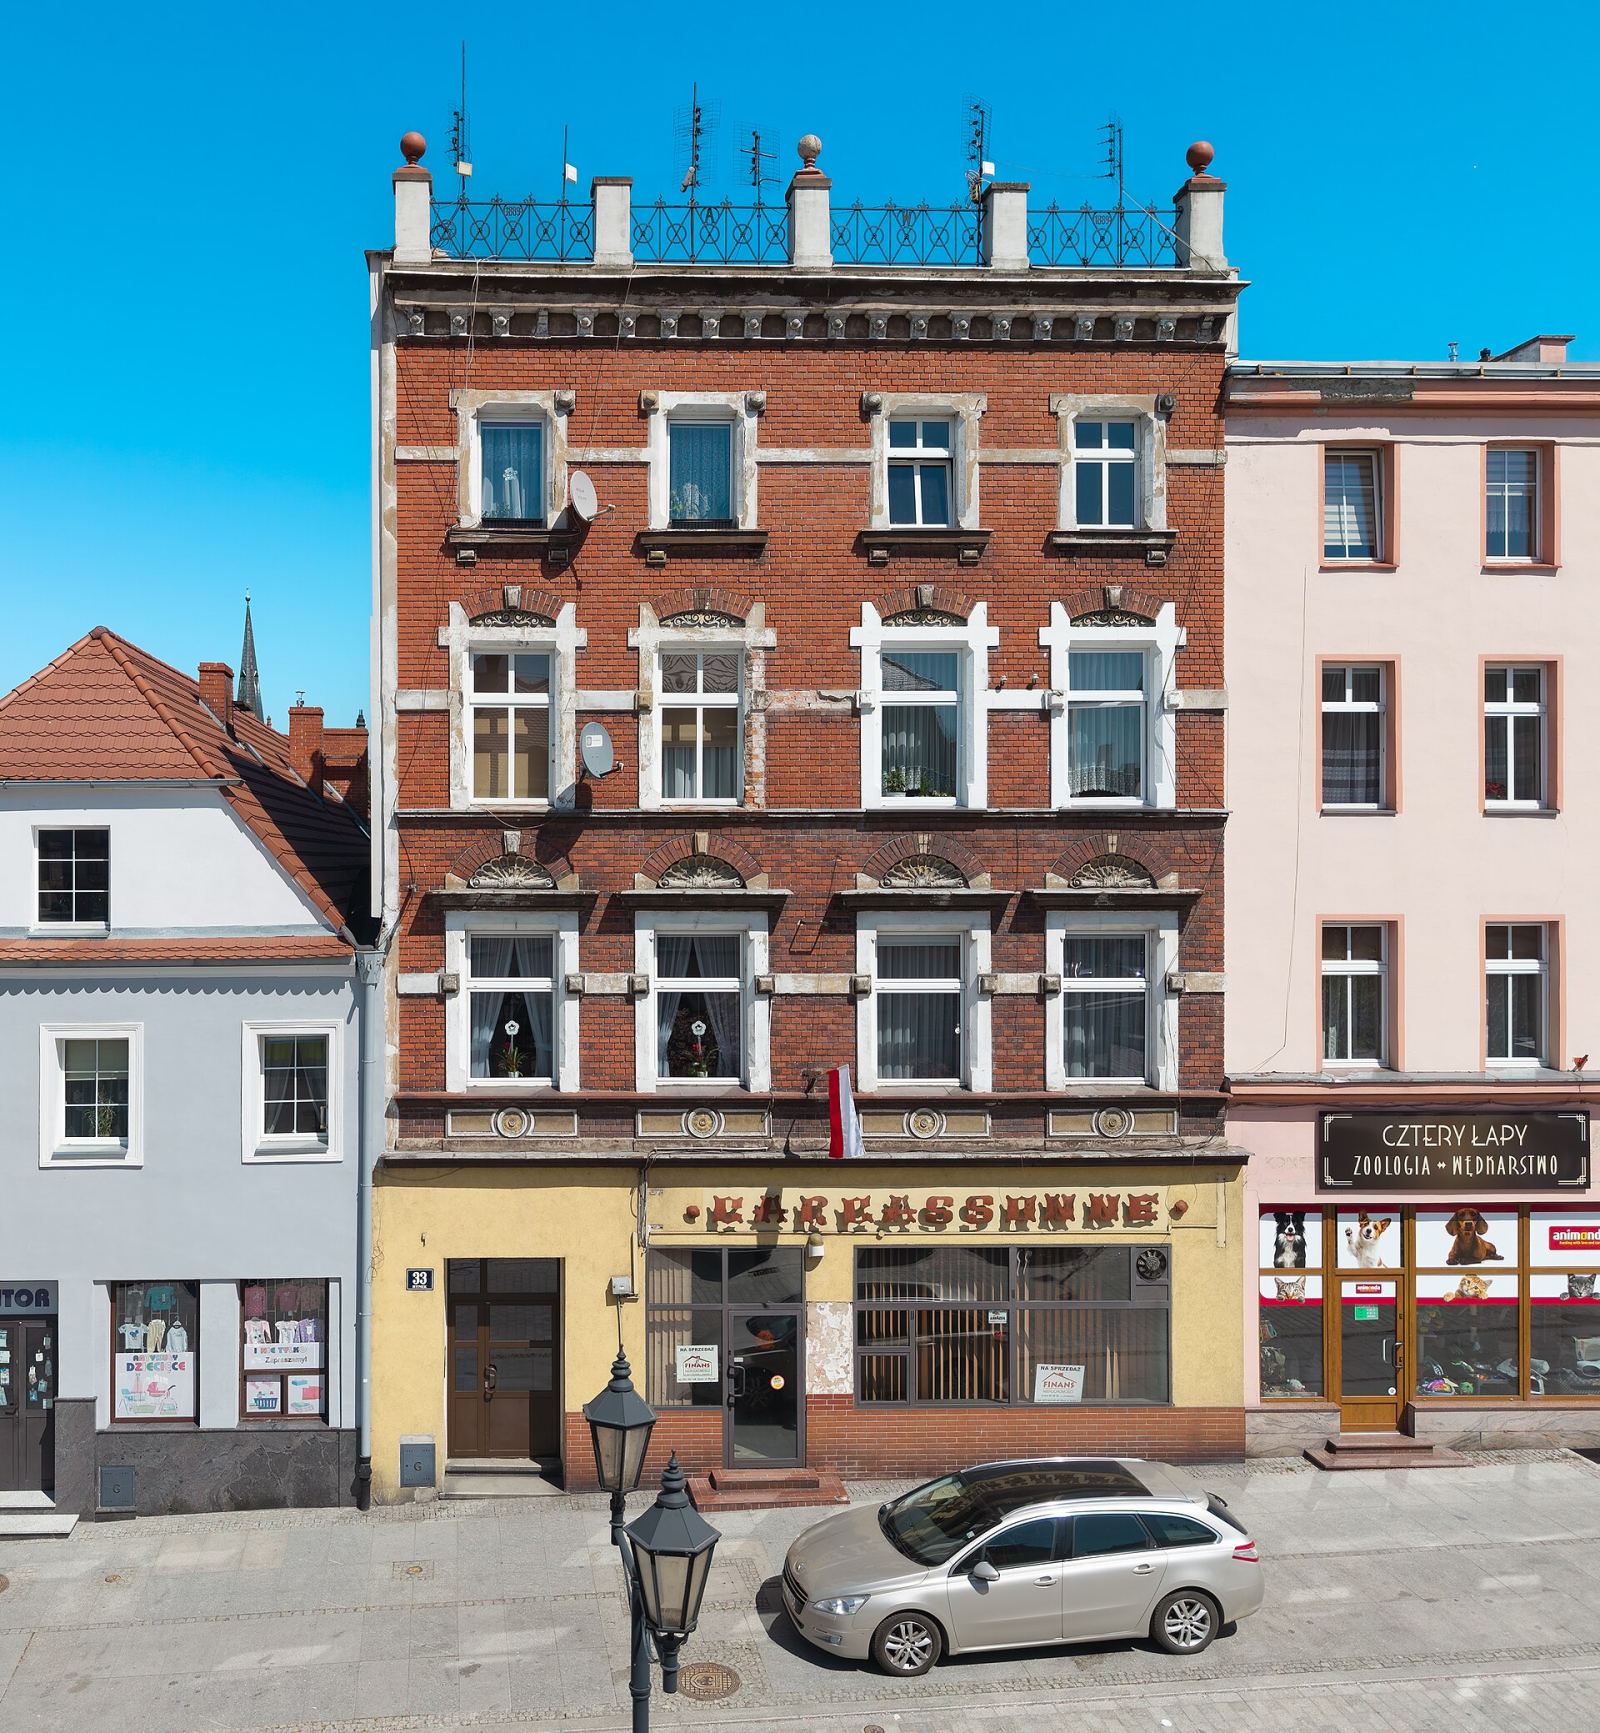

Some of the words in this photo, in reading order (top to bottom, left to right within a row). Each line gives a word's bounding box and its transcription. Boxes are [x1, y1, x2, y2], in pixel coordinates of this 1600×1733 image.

[1382, 1124, 1466, 1147] CZTERY
[1471, 1124, 1528, 1147] ŁAPY
[1353, 1155, 1431, 1176] ZOOLOGIA
[1452, 1155, 1558, 1177] WĘDKARSTWO
[712, 1193, 1159, 1226] CARCASSONNE
[412, 1271, 427, 1285] 33
[0, 1288, 50, 1308] TOR
